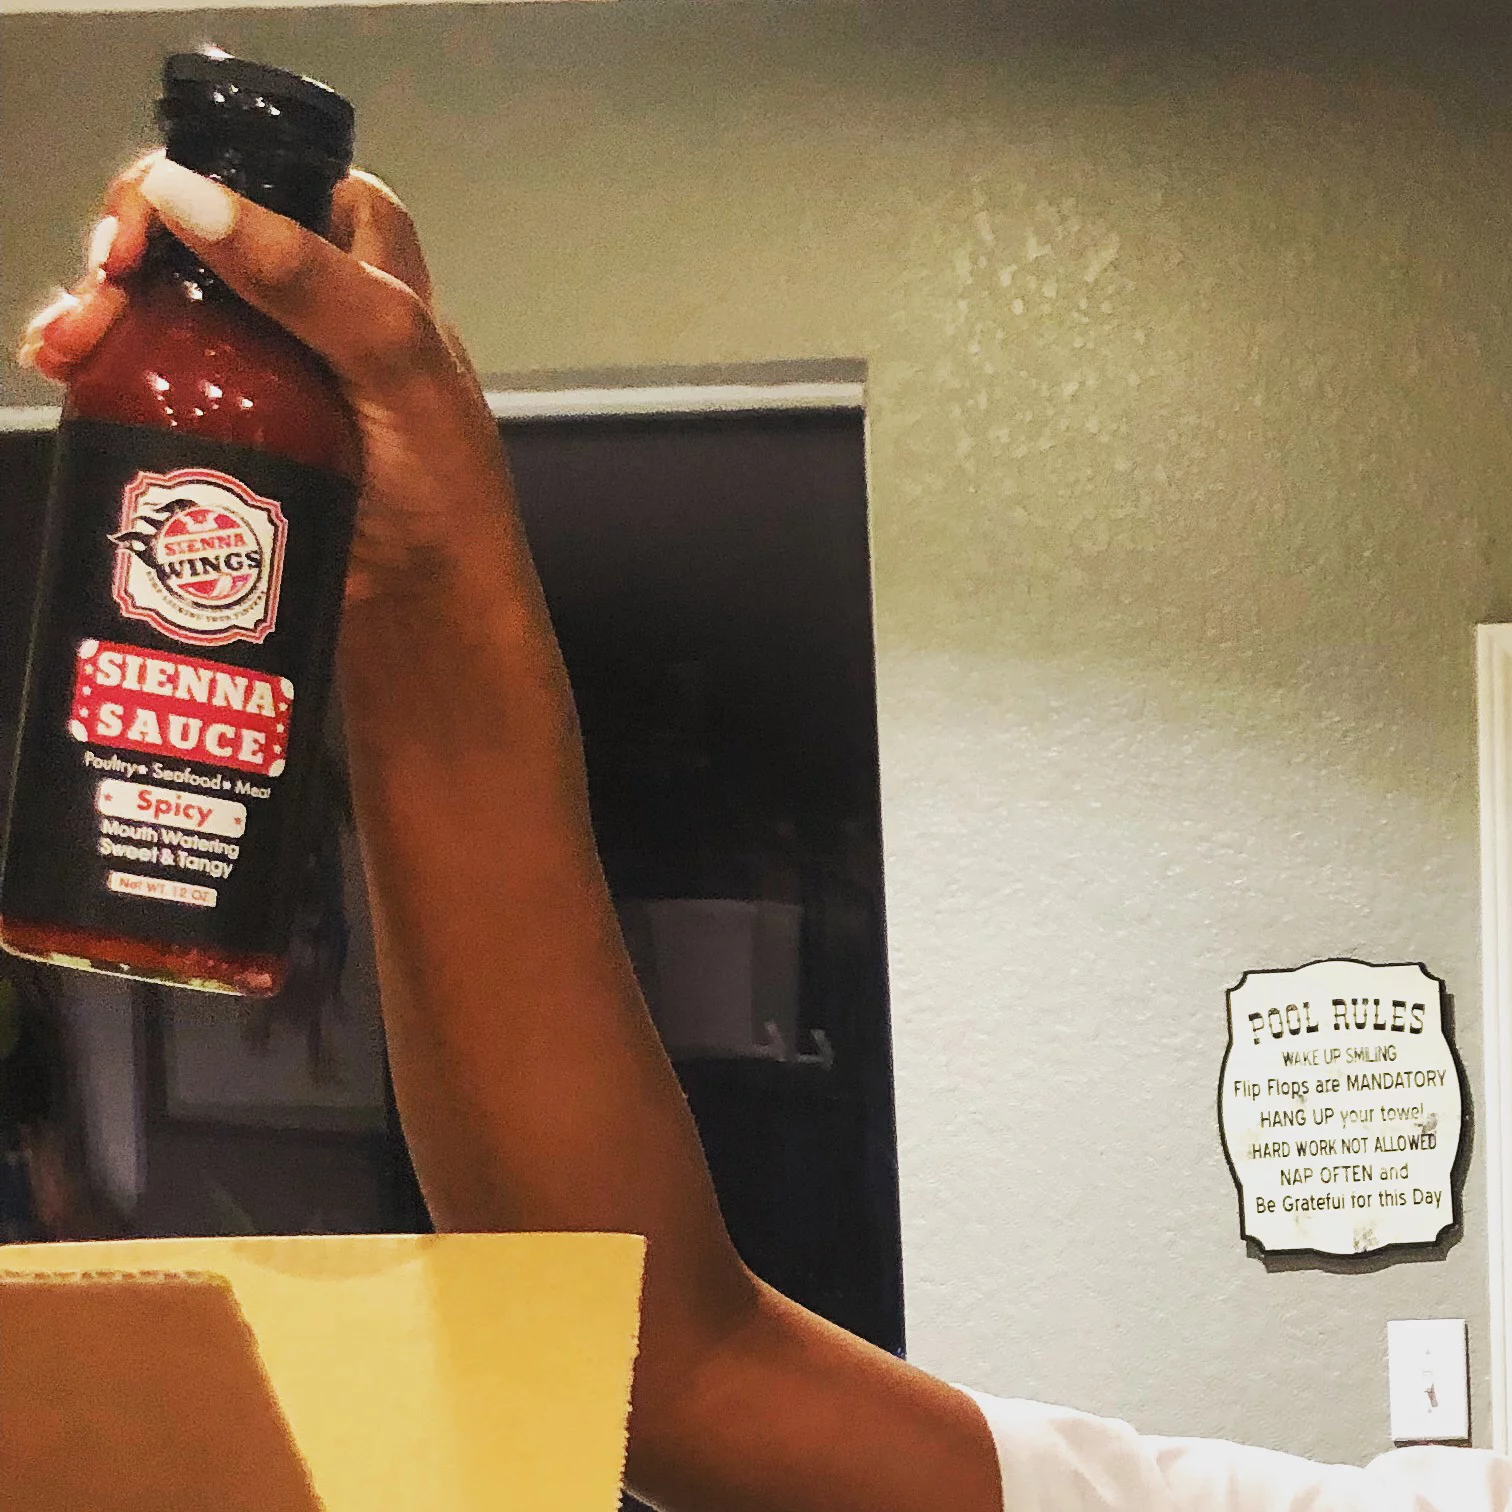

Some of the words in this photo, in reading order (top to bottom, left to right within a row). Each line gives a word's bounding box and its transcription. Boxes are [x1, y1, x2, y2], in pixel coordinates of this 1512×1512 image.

[164, 533, 248, 556] SIENNA
[163, 550, 261, 579] WINGS
[96, 651, 276, 718] SIENNA
[96, 702, 266, 764] SAUCE
[152, 761, 222, 790] Seafood
[137, 789, 213, 827] Spicy
[100, 818, 158, 843] Mouth
[160, 827, 240, 860] Watering
[99, 836, 158, 864] Sweet
[177, 849, 233, 879] Tangy
[1248, 1001, 1319, 1045] POOL
[1332, 998, 1426, 1035] RULES
[1282, 1049, 1319, 1067] WAKE
[1324, 1048, 1341, 1065] UP
[1345, 1044, 1397, 1064] SMILING
[1233, 1080, 1261, 1101] Flip
[1267, 1078, 1310, 1099] Flops
[1315, 1078, 1340, 1094] are
[1346, 1069, 1446, 1092] MANDATORY
[1260, 1108, 1307, 1129] HANG
[1312, 1107, 1335, 1126] UP
[1340, 1108, 1375, 1130] your
[1380, 1102, 1425, 1122] towel
[1252, 1141, 1291, 1160] HARD
[1295, 1139, 1337, 1157] WORK
[1341, 1137, 1369, 1155] NOT
[1374, 1133, 1437, 1153] ALLOWED
[1280, 1168, 1314, 1186] NAP
[1320, 1164, 1373, 1184] OFTEN
[1379, 1162, 1409, 1181] and
[1256, 1196, 1277, 1214] Be
[1282, 1192, 1346, 1213] Grateful
[1351, 1193, 1373, 1209] for
[1378, 1189, 1408, 1207] this
[1413, 1187, 1443, 1209] Day
